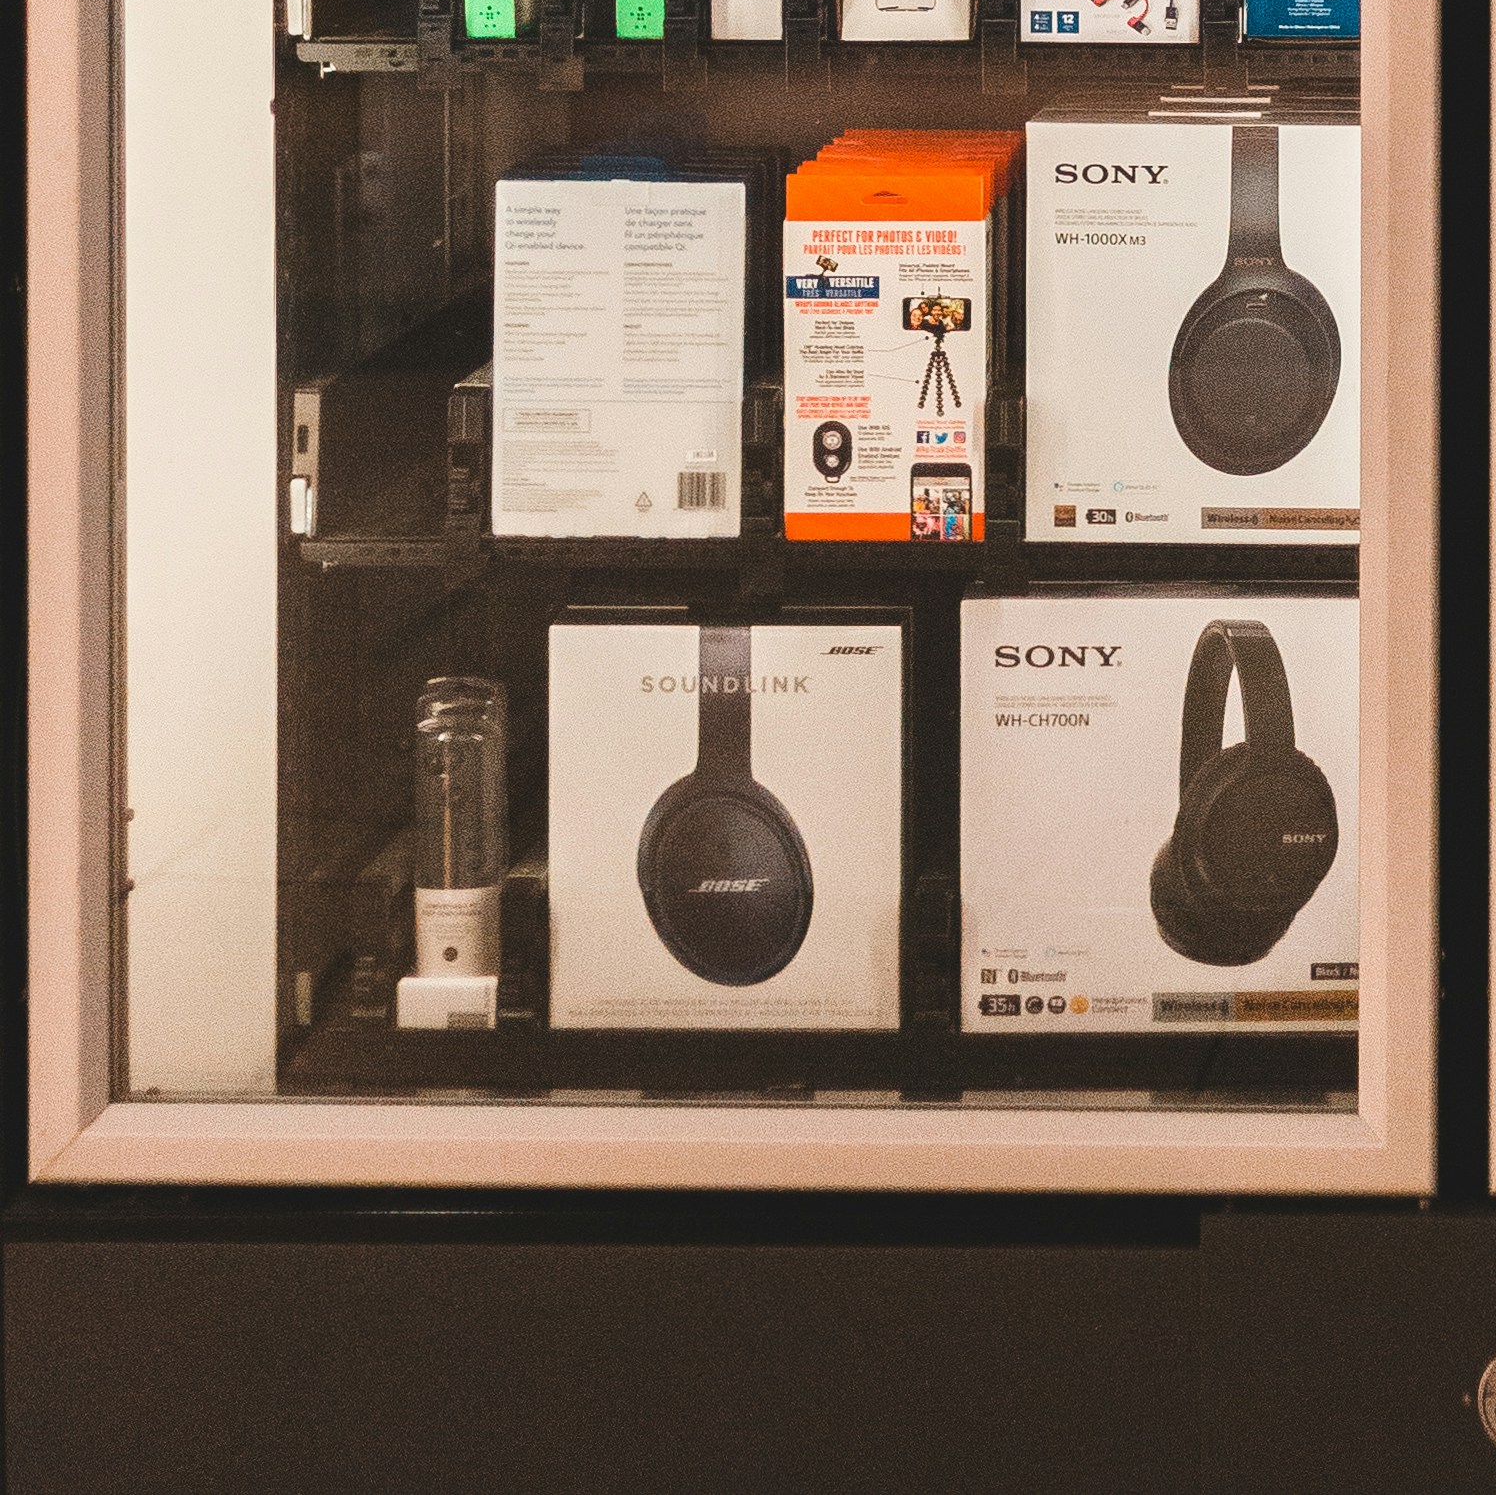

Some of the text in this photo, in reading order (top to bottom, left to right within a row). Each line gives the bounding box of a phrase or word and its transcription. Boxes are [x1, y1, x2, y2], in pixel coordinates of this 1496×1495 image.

[1062, 14, 1074, 24] 12
[1055, 163, 1166, 184] SONY
[812, 229, 957, 242] PERFECT FOR PHOTOS VIDEO!
[803, 244, 931, 255] PARFAIT POUR LES PHOTOS ET LES
[795, 277, 875, 289] VERY VERSATILE
[820, 645, 884, 655] BOSE
[995, 646, 1121, 668] SONY
[641, 675, 810, 693] SOUNDLINK
[995, 714, 1090, 727] WH-CH700N
[1282, 834, 1326, 843] SONY
[688, 878, 770, 893] BOSE
